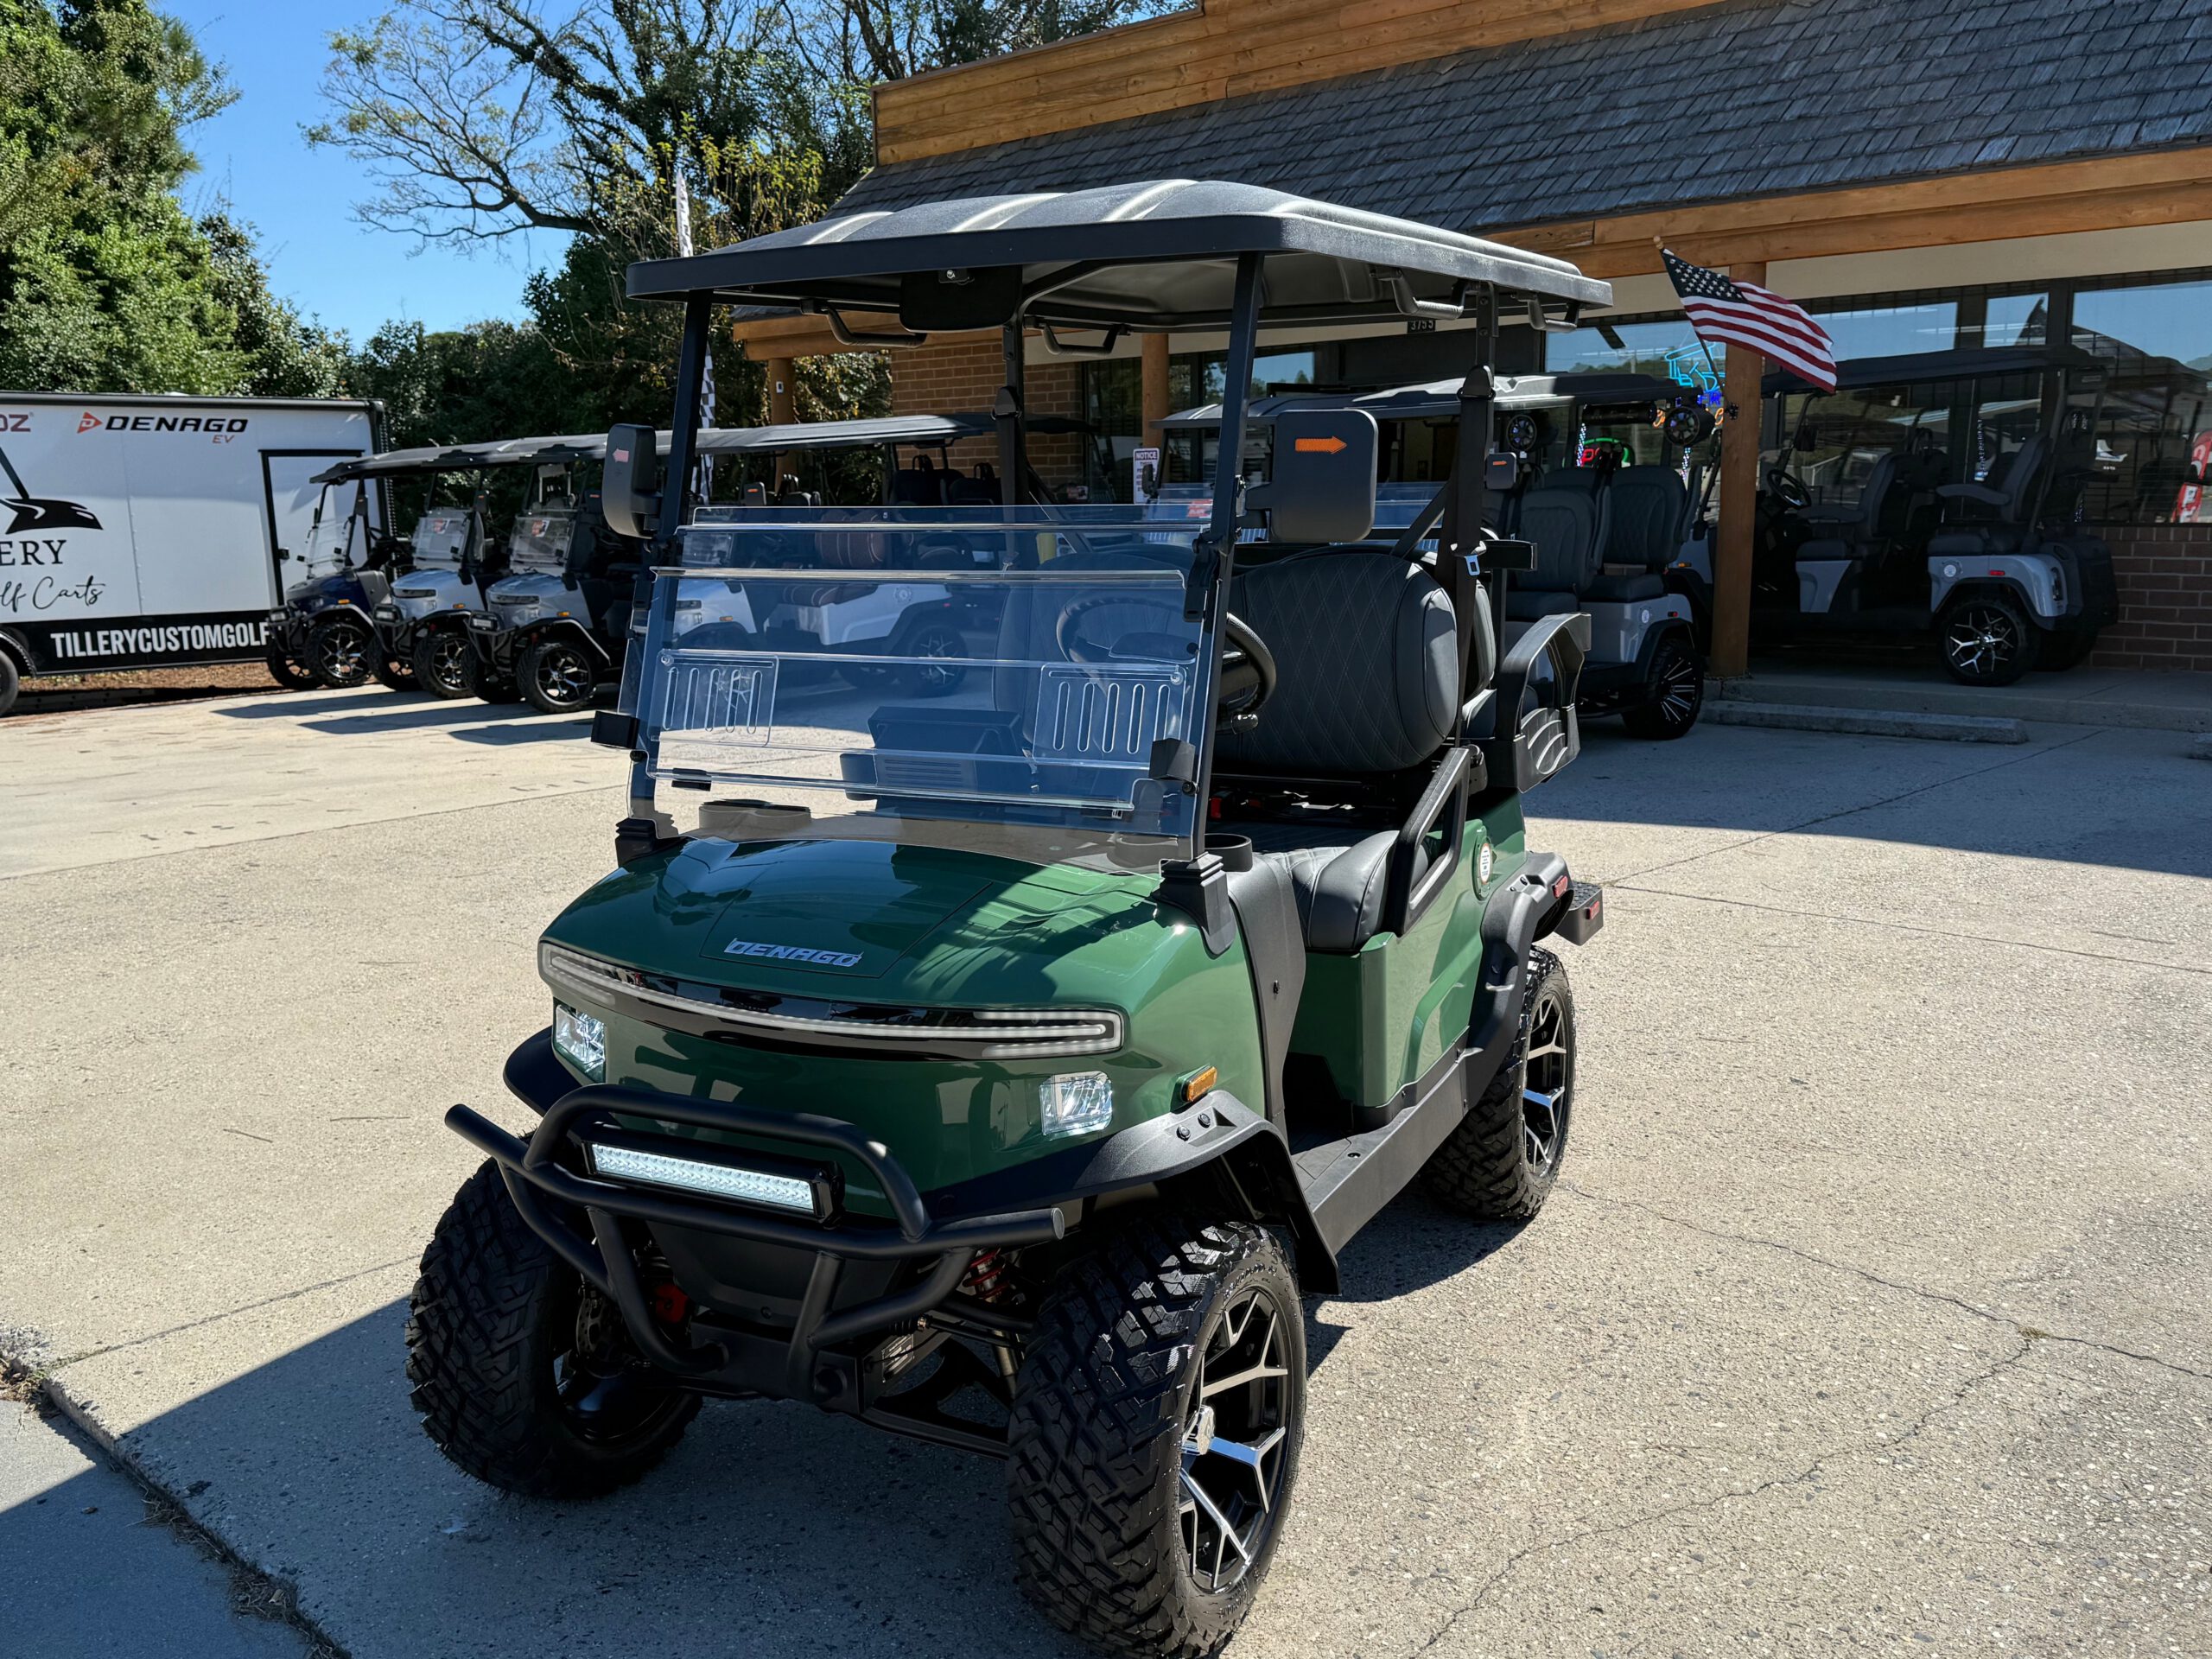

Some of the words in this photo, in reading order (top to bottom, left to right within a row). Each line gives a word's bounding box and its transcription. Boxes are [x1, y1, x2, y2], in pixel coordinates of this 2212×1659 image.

[105, 416, 248, 433] DENAGO
[212, 435, 235, 444] EV
[1135, 451, 1158, 460] NOTICE
[32, 575, 105, 610] Carts
[724, 938, 864, 967] DENAGO
